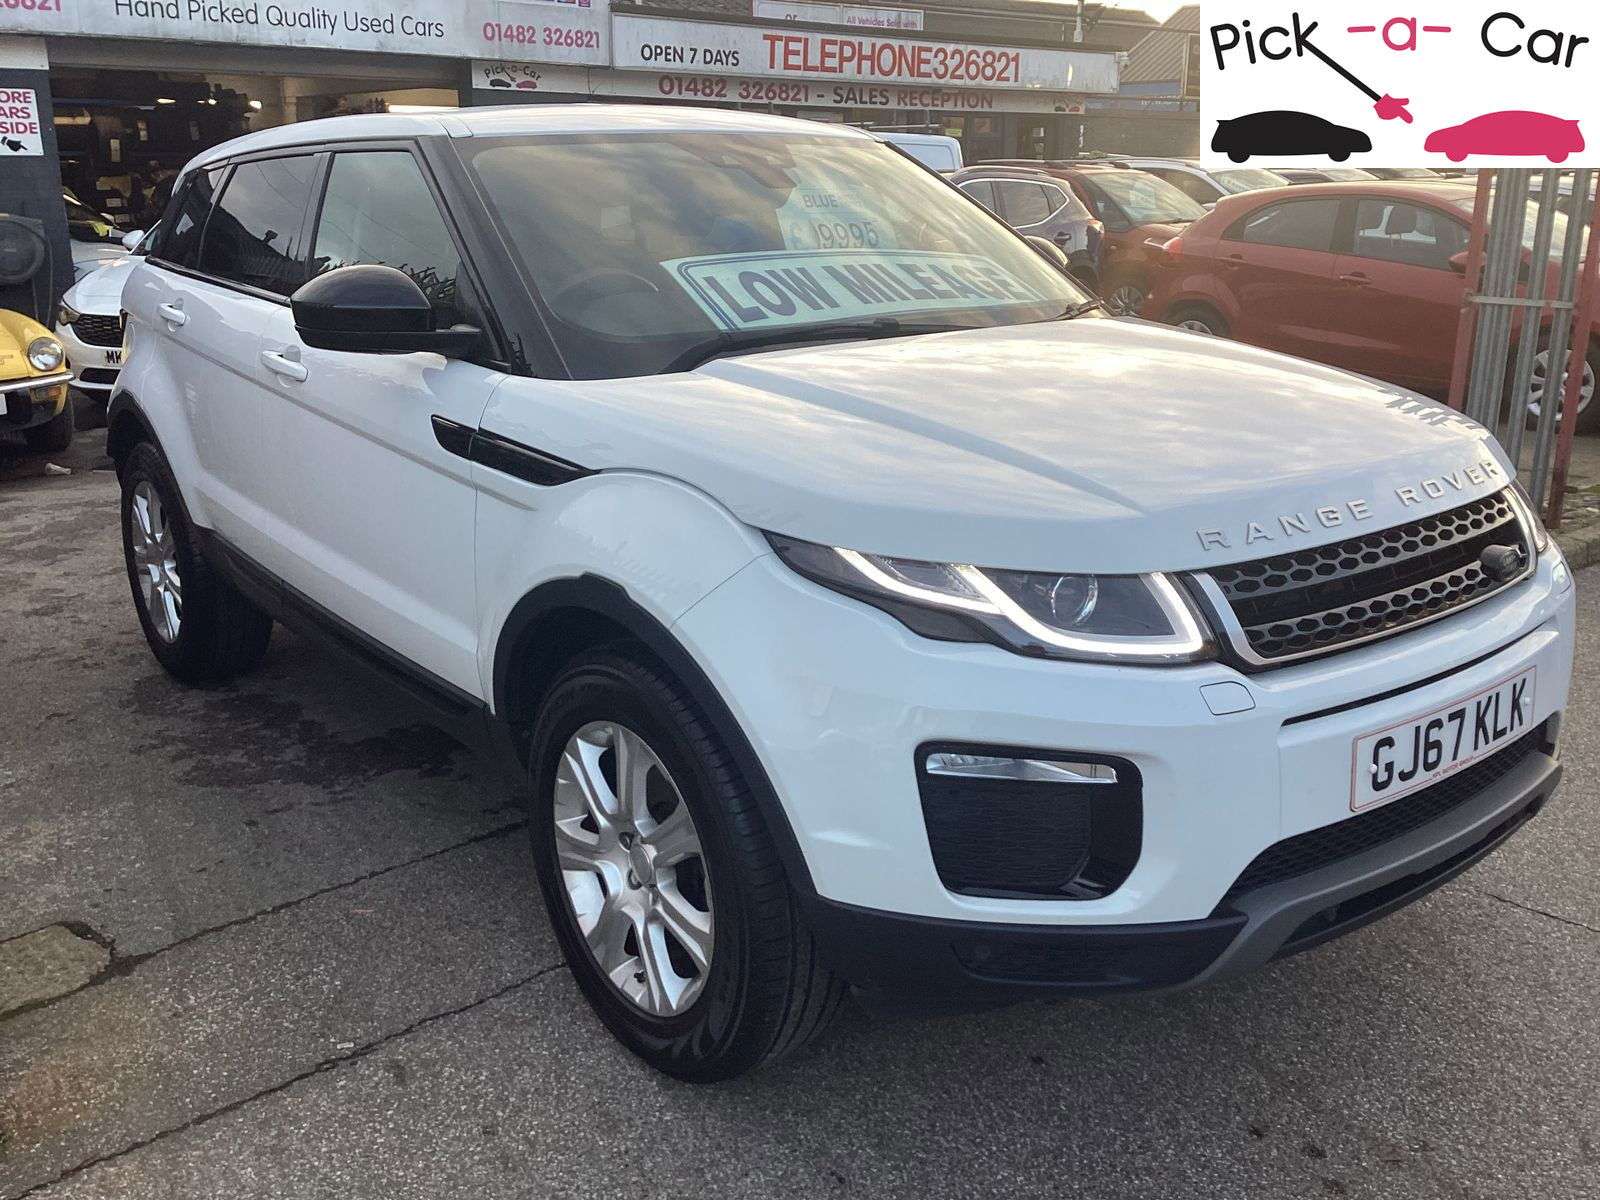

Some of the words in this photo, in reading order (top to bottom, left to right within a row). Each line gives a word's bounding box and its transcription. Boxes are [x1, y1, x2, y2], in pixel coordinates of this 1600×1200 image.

[115, 0, 179, 19] Hand
[188, 0, 259, 24] Picked
[266, 5, 337, 36] Quality
[344, 11, 394, 34] Used
[401, 16, 444, 38] Cars
[483, 22, 536, 44] 01482
[543, 26, 600, 48] 326821
[640, 43, 684, 63] OPEN
[689, 47, 698, 64] 7
[703, 49, 740, 67] DAYS
[658, 74, 728, 98] 01482
[738, 80, 809, 103] 326821
[833, 86, 889, 106] SALES
[896, 89, 993, 109] RECEPTION
[802, 194, 839, 208] BLUE
[703, 267, 841, 323] LOW
[823, 261, 1027, 304] MILEAGE
[1195, 498, 1373, 551] RANGE
[1394, 461, 1500, 506] ROVER
[1371, 707, 1466, 792] GJ67
[1474, 678, 1527, 751] KLK
